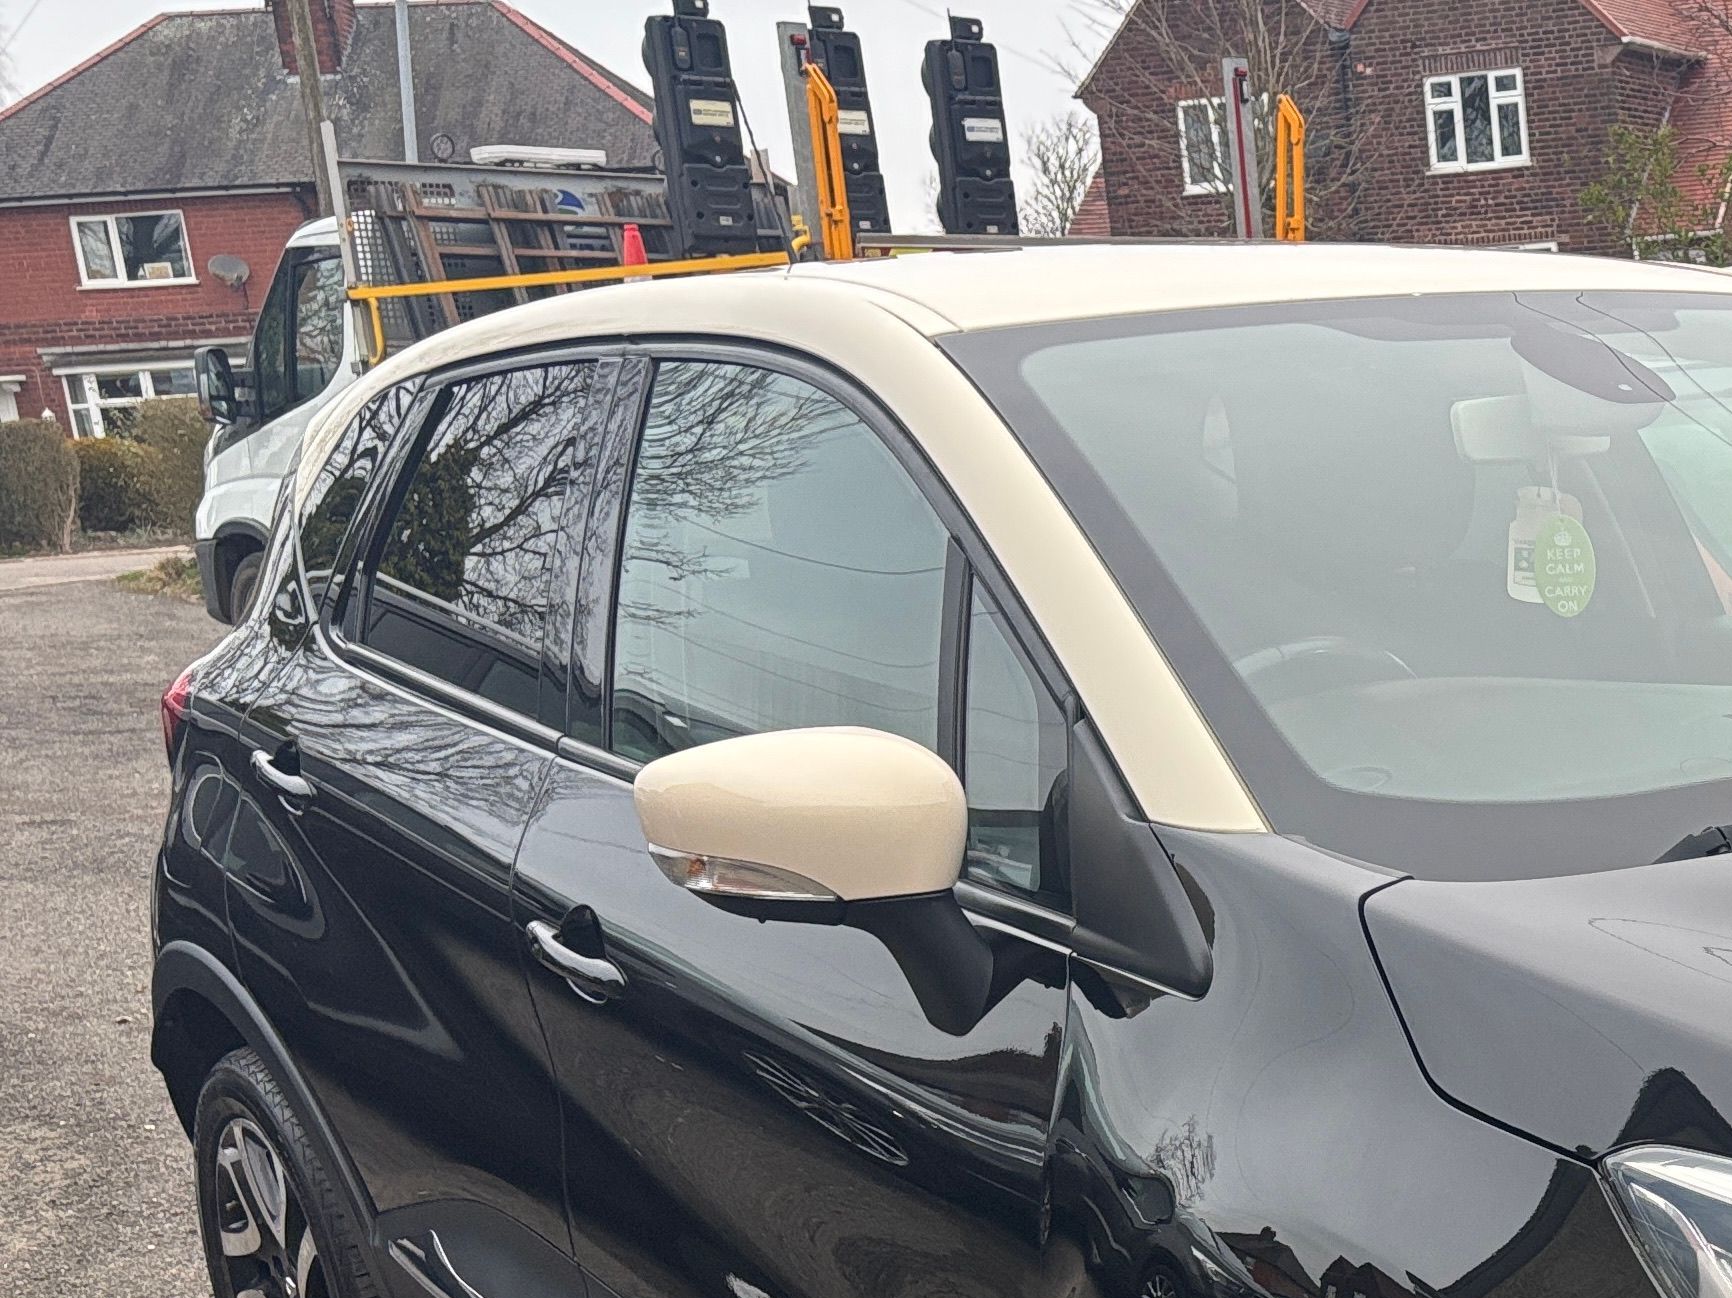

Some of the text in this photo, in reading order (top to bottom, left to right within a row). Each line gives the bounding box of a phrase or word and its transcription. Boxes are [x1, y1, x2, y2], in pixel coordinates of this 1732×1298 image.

[1546, 547, 1581, 560] KEEP
[1545, 562, 1584, 575] CALM
[1544, 585, 1588, 598] CARRY
[1557, 600, 1578, 612] ON
